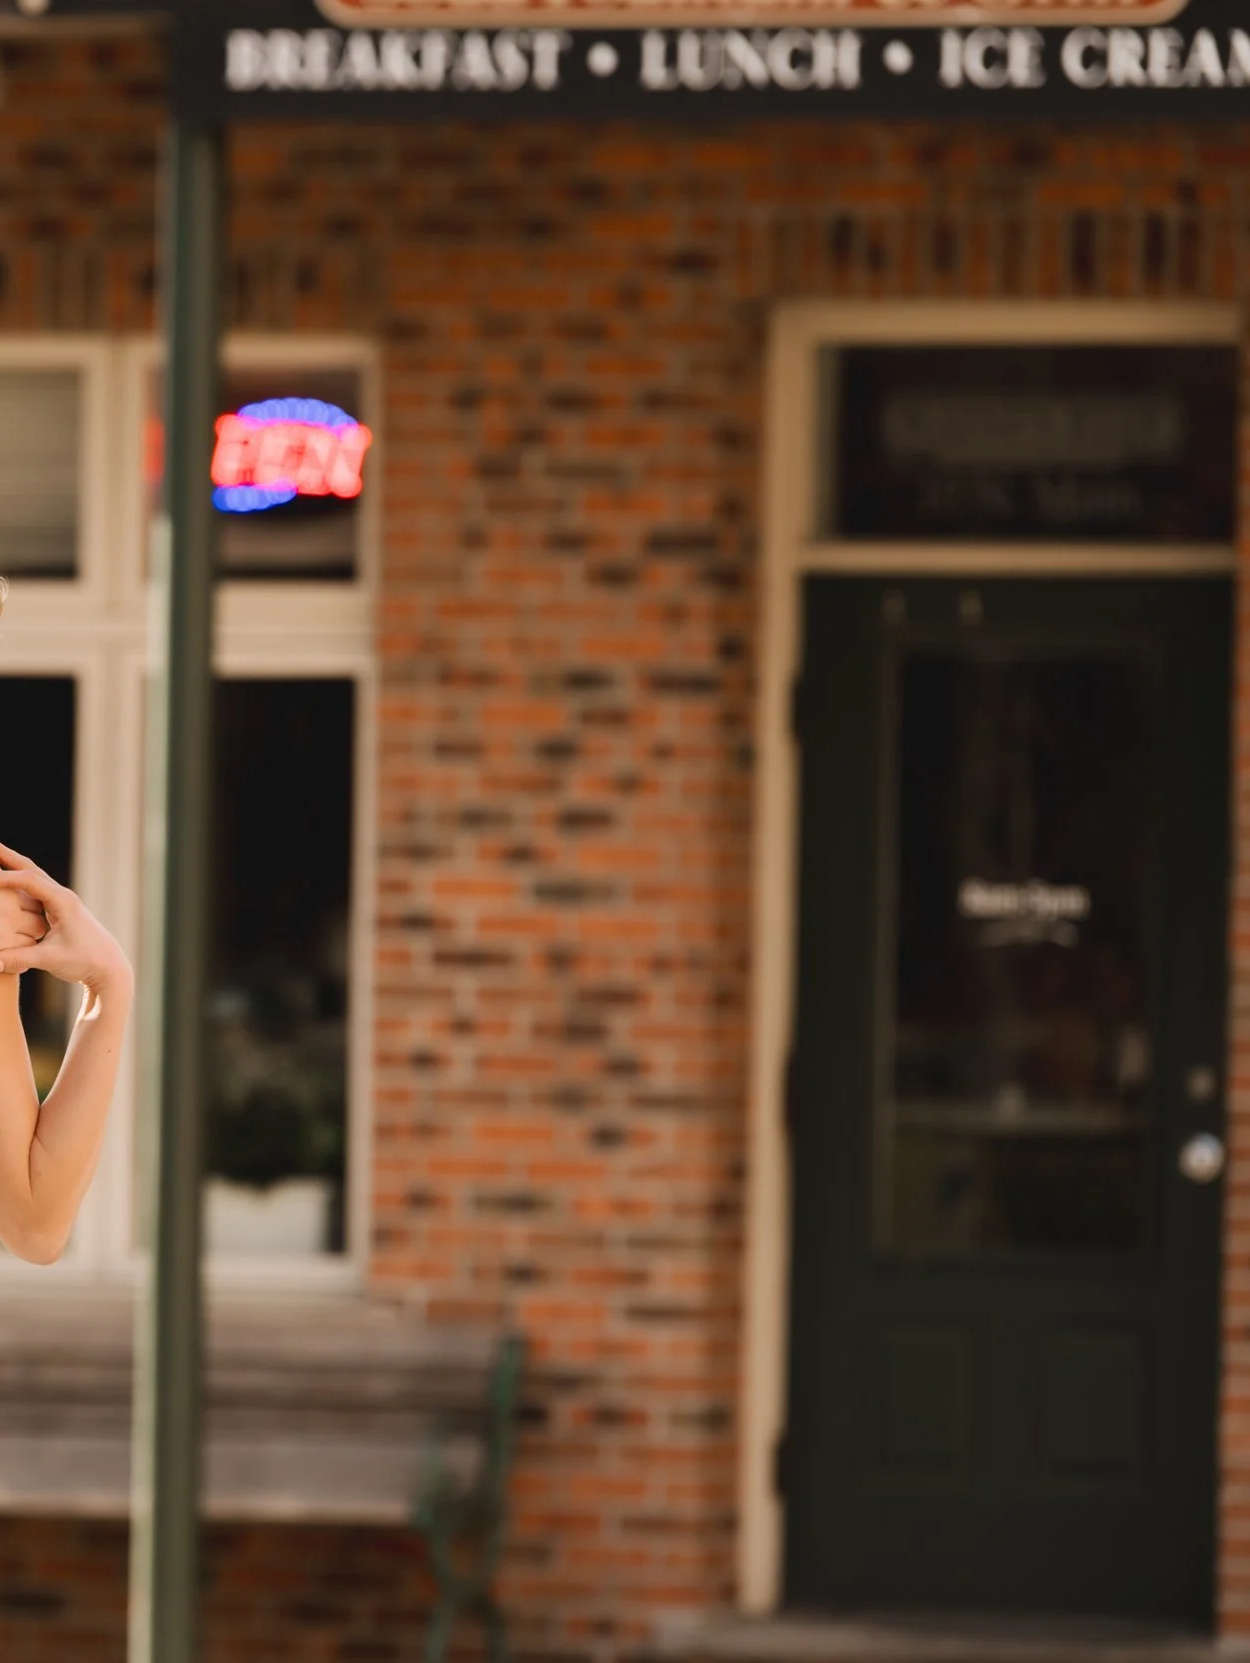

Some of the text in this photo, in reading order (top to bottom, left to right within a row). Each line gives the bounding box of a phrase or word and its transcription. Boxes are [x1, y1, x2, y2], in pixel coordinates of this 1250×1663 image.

[224, 27, 570, 91] BREAKFAST
[641, 27, 861, 90] LUNCH
[939, 27, 1045, 89] ICE
